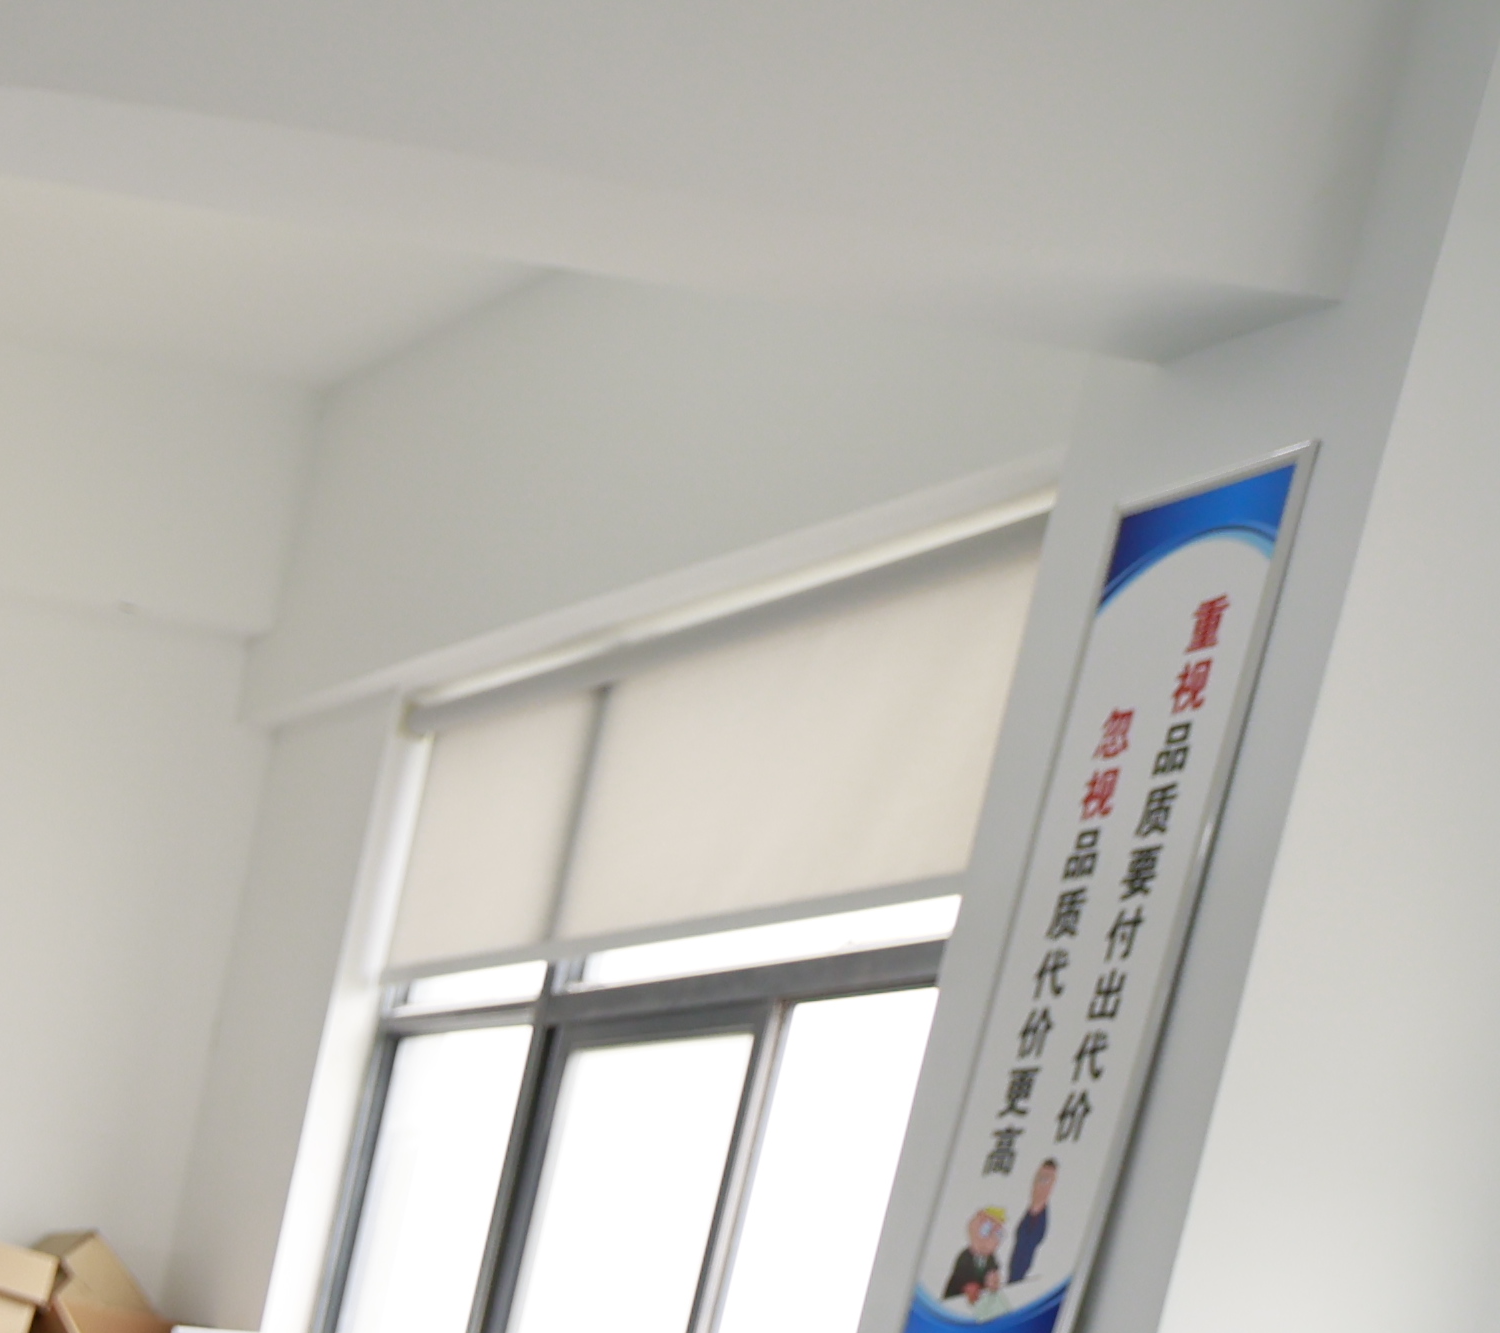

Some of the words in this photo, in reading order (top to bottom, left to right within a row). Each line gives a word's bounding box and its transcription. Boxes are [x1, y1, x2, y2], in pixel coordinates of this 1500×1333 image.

[981, 707, 1135, 1177] 忽视品质代价更高
[1056, 593, 1231, 1145] 重视品质要付出代价
